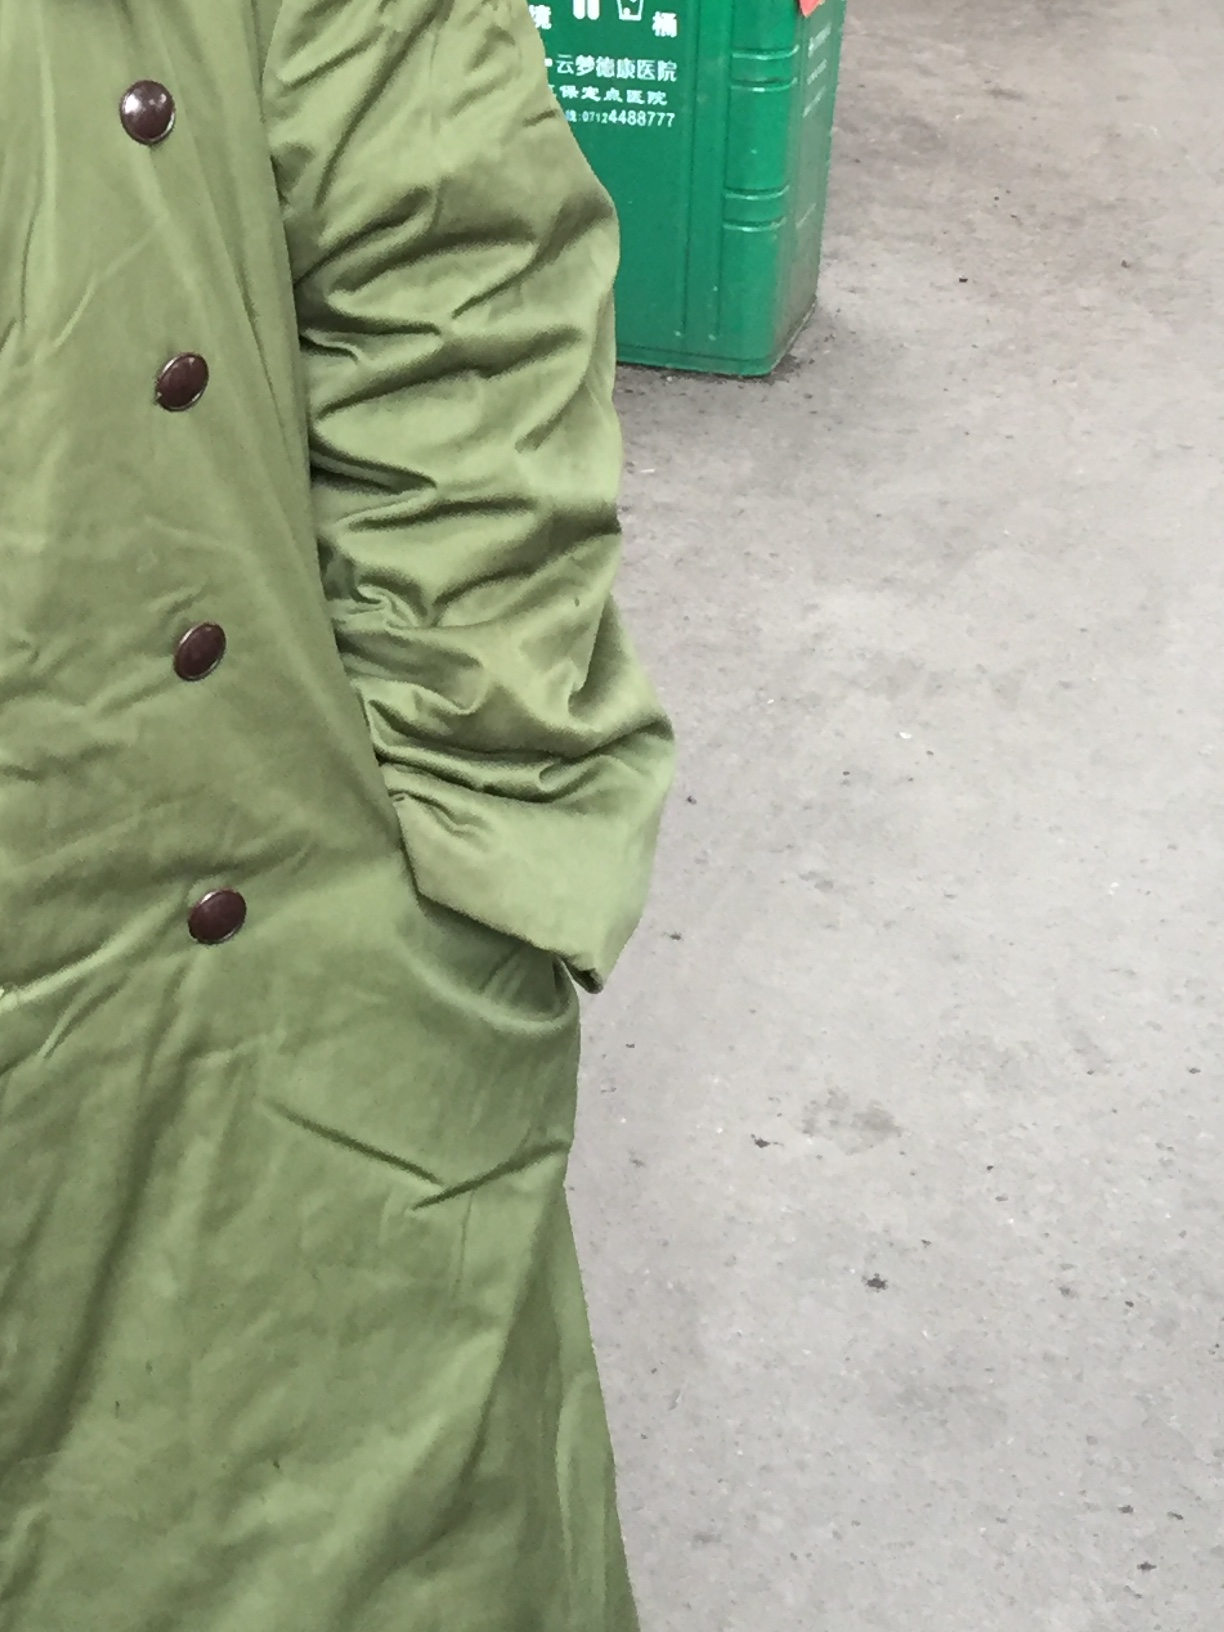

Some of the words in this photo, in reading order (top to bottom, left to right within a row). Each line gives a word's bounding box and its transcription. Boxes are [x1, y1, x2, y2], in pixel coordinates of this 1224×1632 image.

[555, 54, 677, 82] 云梦德康医院
[548, 84, 668, 106] 保定点医院
